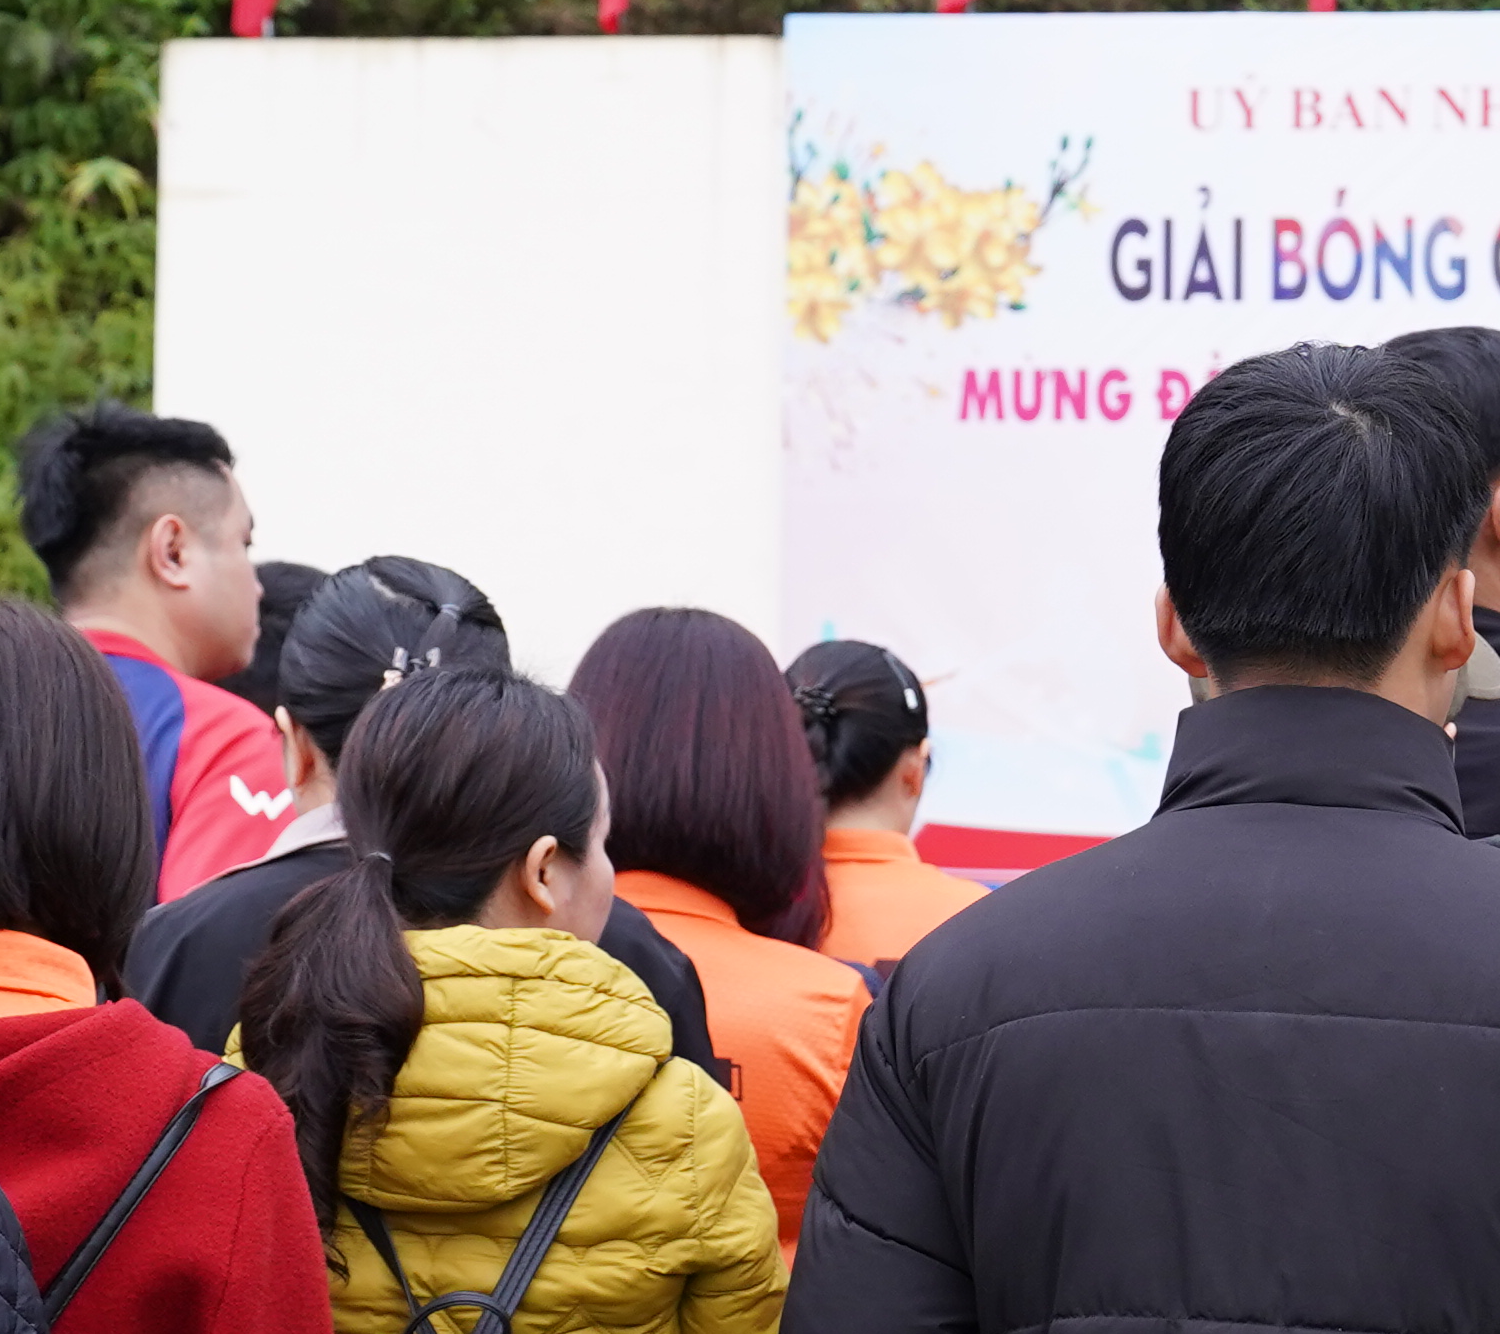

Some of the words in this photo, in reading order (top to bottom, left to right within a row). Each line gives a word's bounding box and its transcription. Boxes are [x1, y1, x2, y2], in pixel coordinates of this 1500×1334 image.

[1292, 87, 1409, 130] BAN
[1111, 185, 1243, 302] GIẢI
[1272, 186, 1468, 302] BÓNG
